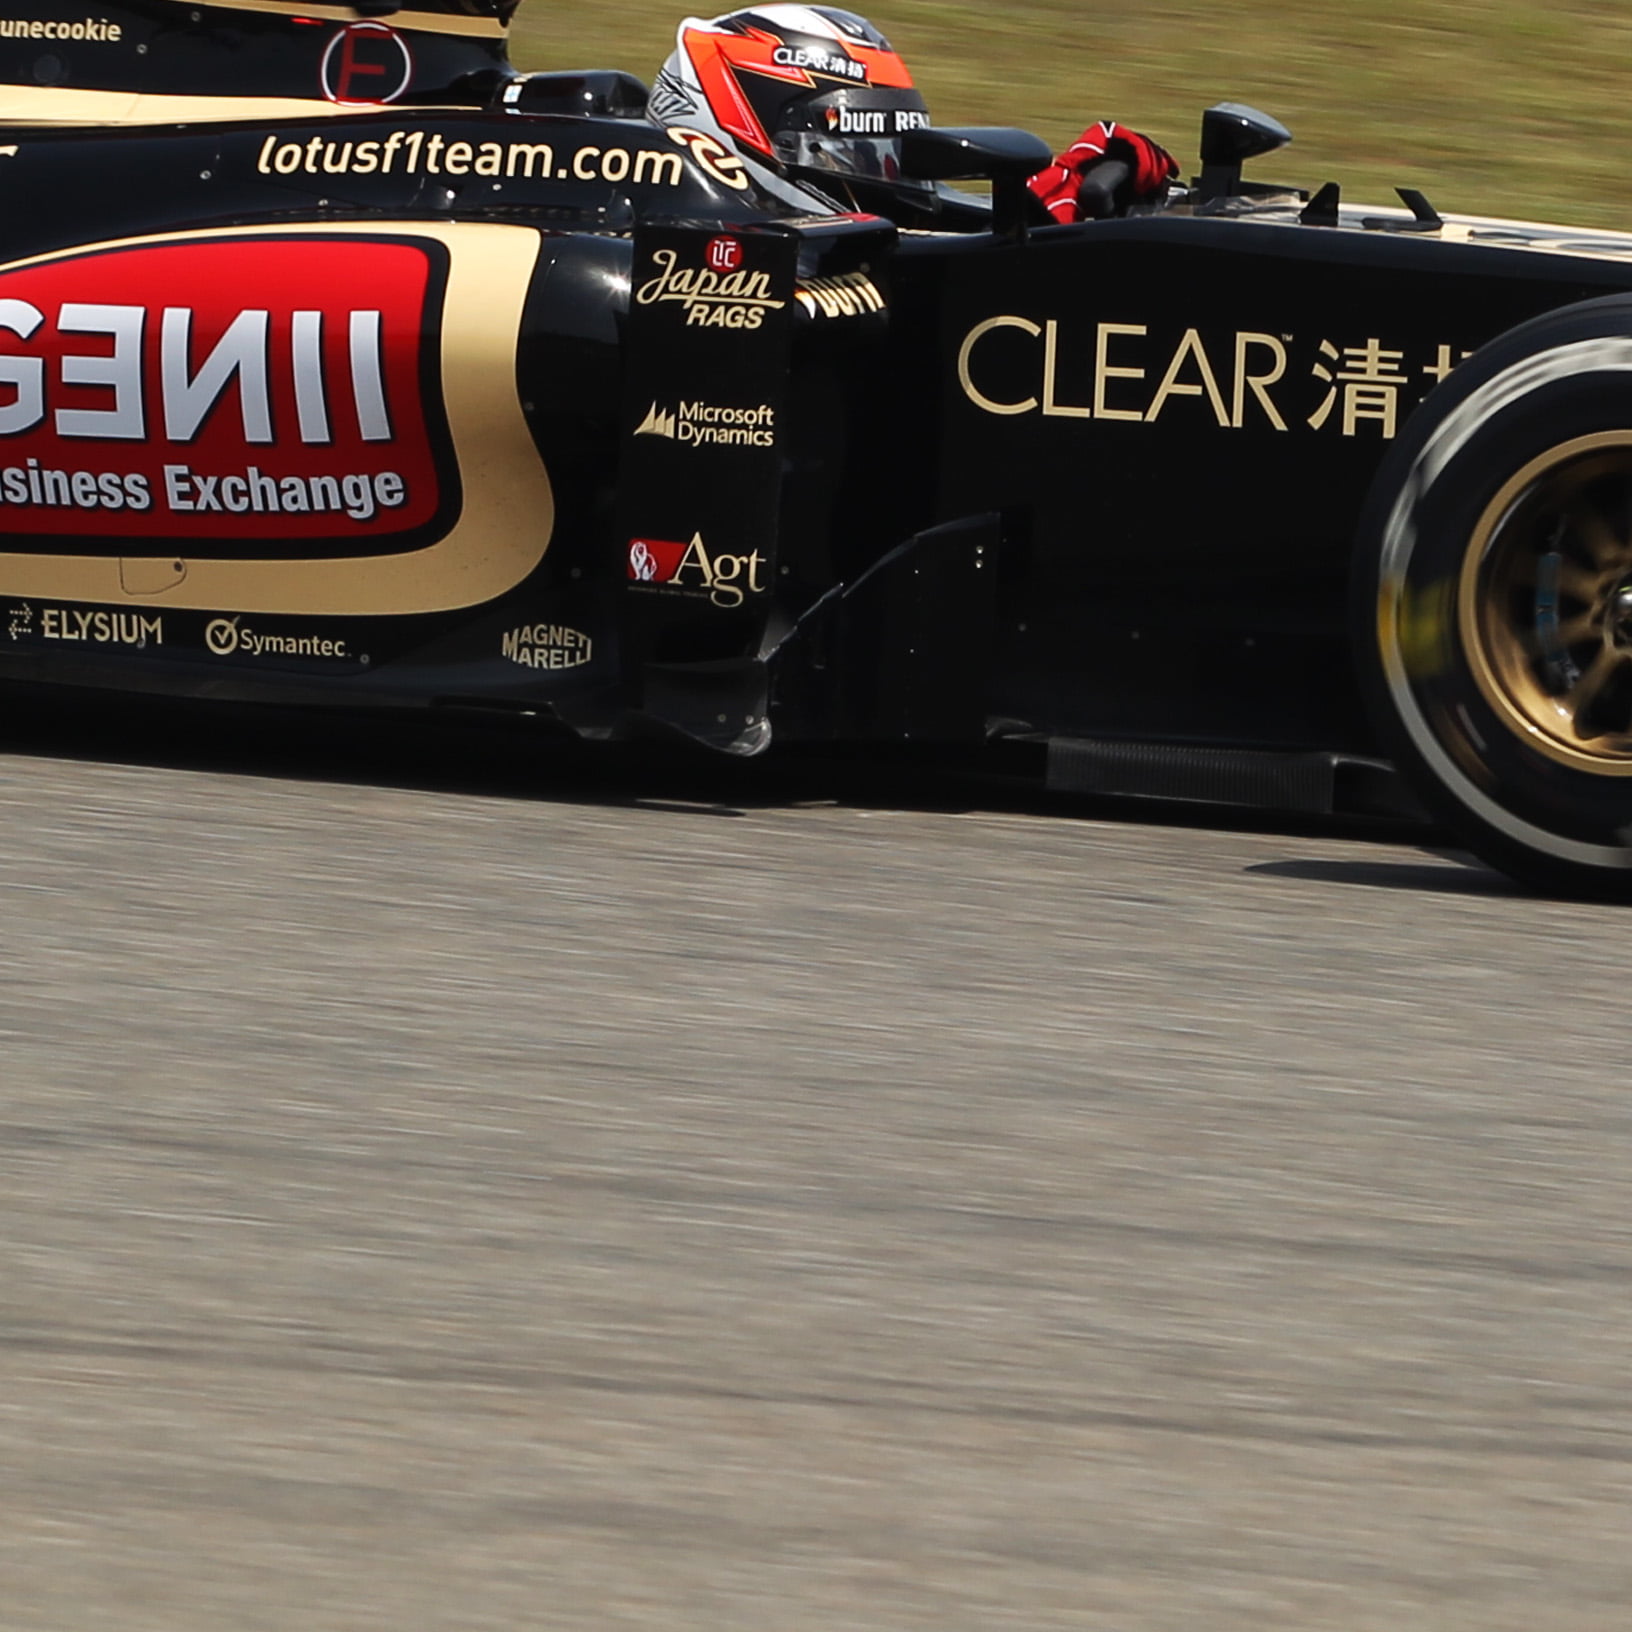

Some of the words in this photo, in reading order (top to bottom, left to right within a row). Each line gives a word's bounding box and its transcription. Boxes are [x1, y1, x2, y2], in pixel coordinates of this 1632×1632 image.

[839, 106, 885, 133] burn
[256, 131, 683, 187] lotusf1team.com
[635, 249, 773, 310] Japan
[685, 303, 766, 330] RAGS
[957, 315, 1289, 431] CLEAR
[679, 400, 774, 426] Microsoft
[677, 421, 774, 447] Dynamics
[166, 463, 405, 522] Exchange
[667, 530, 767, 608] Agt
[41, 609, 163, 645] ELYSIUM
[240, 628, 346, 657] Symantec
